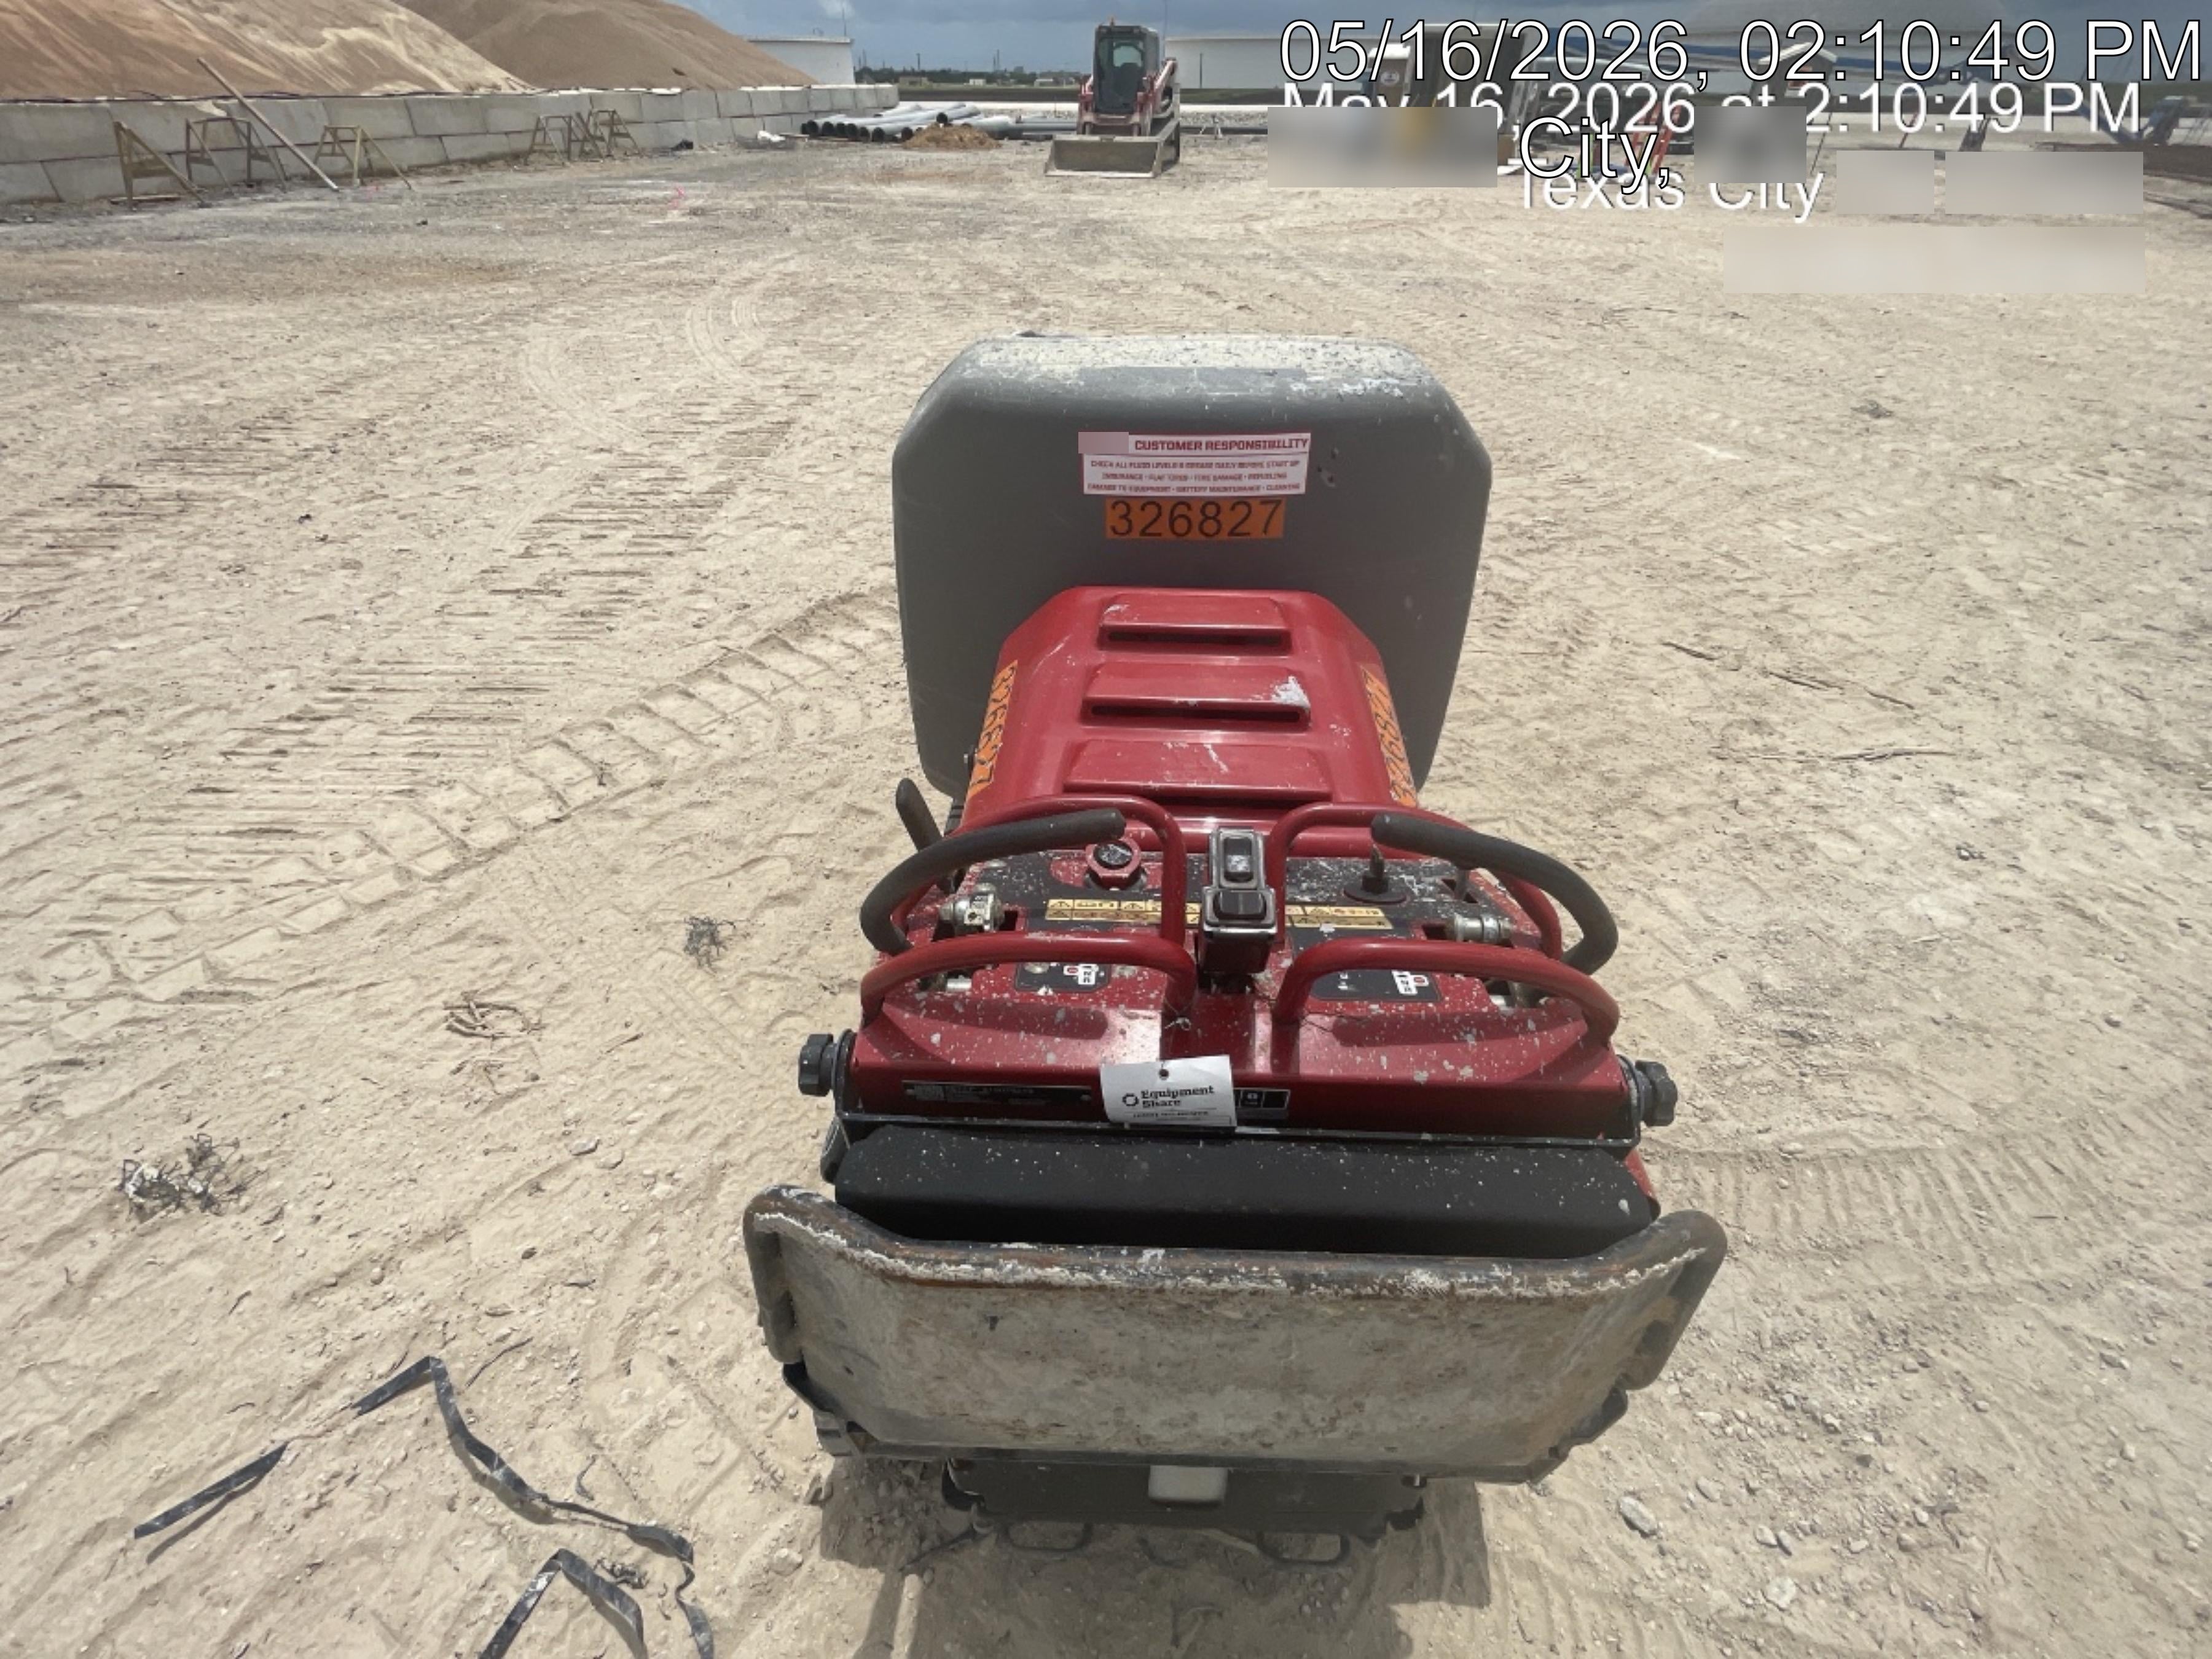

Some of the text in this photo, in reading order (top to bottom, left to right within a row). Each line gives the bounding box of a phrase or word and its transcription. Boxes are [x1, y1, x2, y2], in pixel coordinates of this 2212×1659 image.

[1135, 438, 1309, 451] CUSTOMER RESPONSIBILITY
[1110, 499, 1283, 537] 326827
[1140, 1085, 1214, 1099] Equipment
[1142, 1099, 1181, 1108] Share
